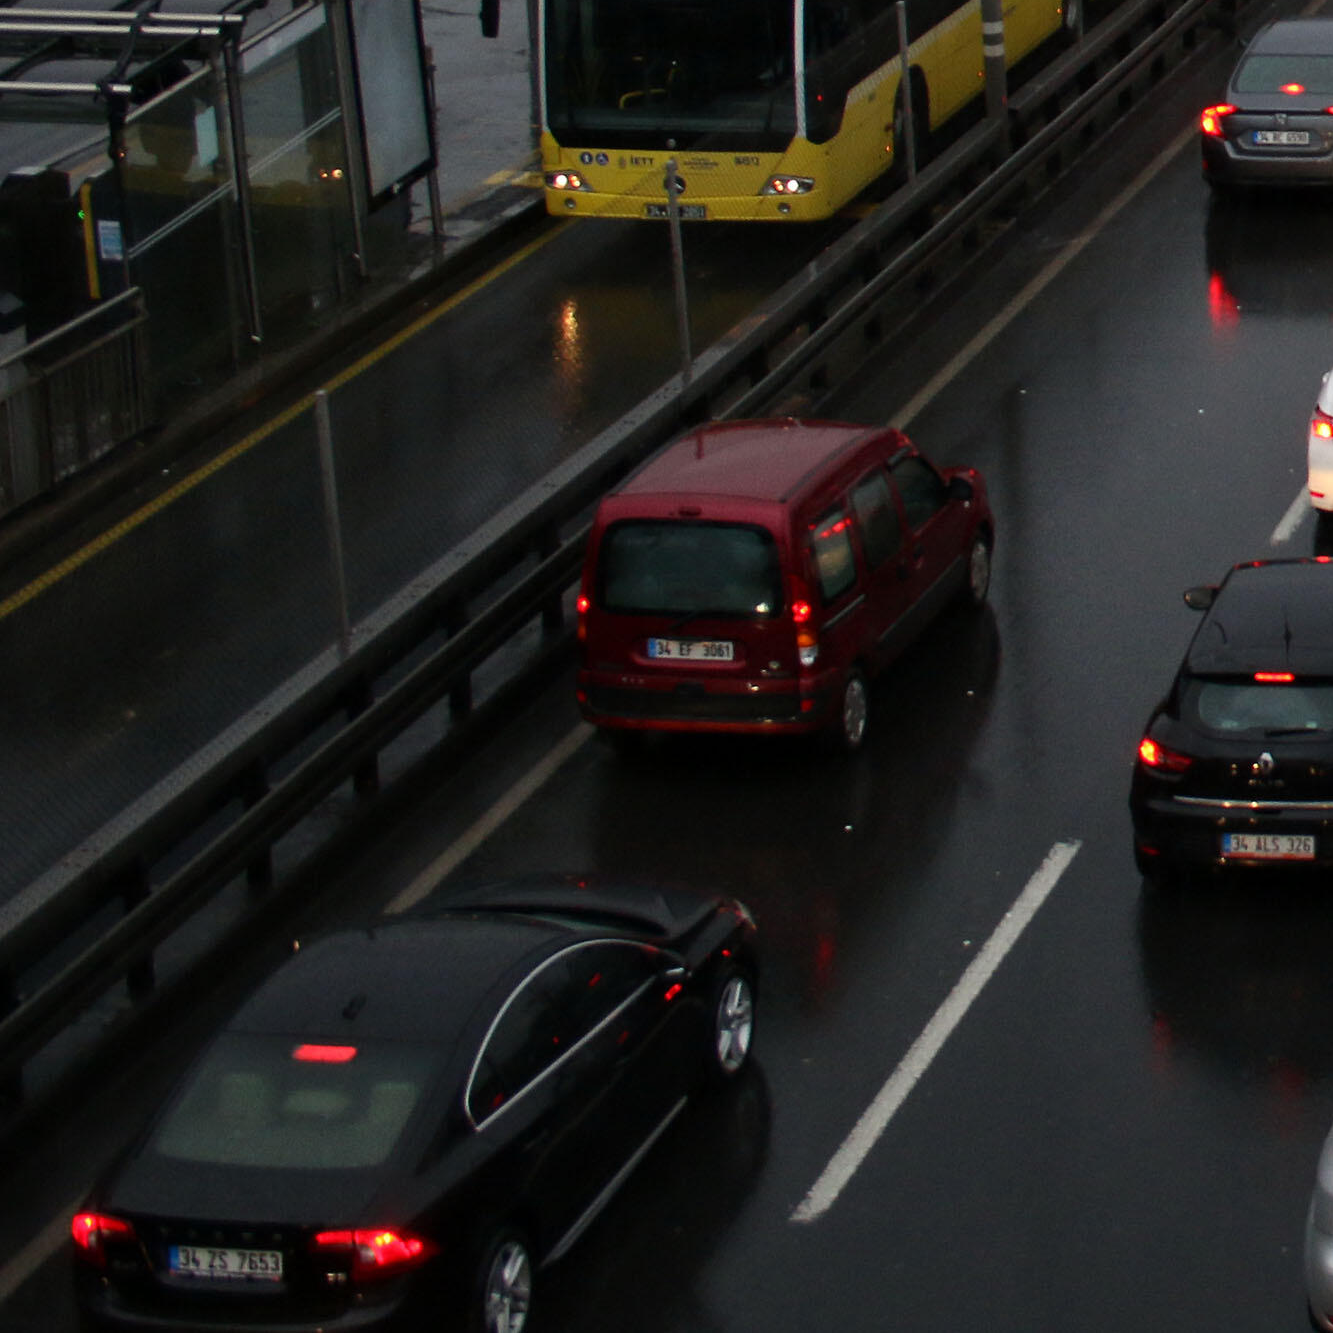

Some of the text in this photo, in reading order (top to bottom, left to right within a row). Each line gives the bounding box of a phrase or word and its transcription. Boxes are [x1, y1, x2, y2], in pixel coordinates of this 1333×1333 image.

[657, 639, 671, 656] 34
[1232, 835, 1248, 851] 34
[1287, 837, 1312, 852] 326
[180, 1248, 281, 1272] 34 ZS 7653
